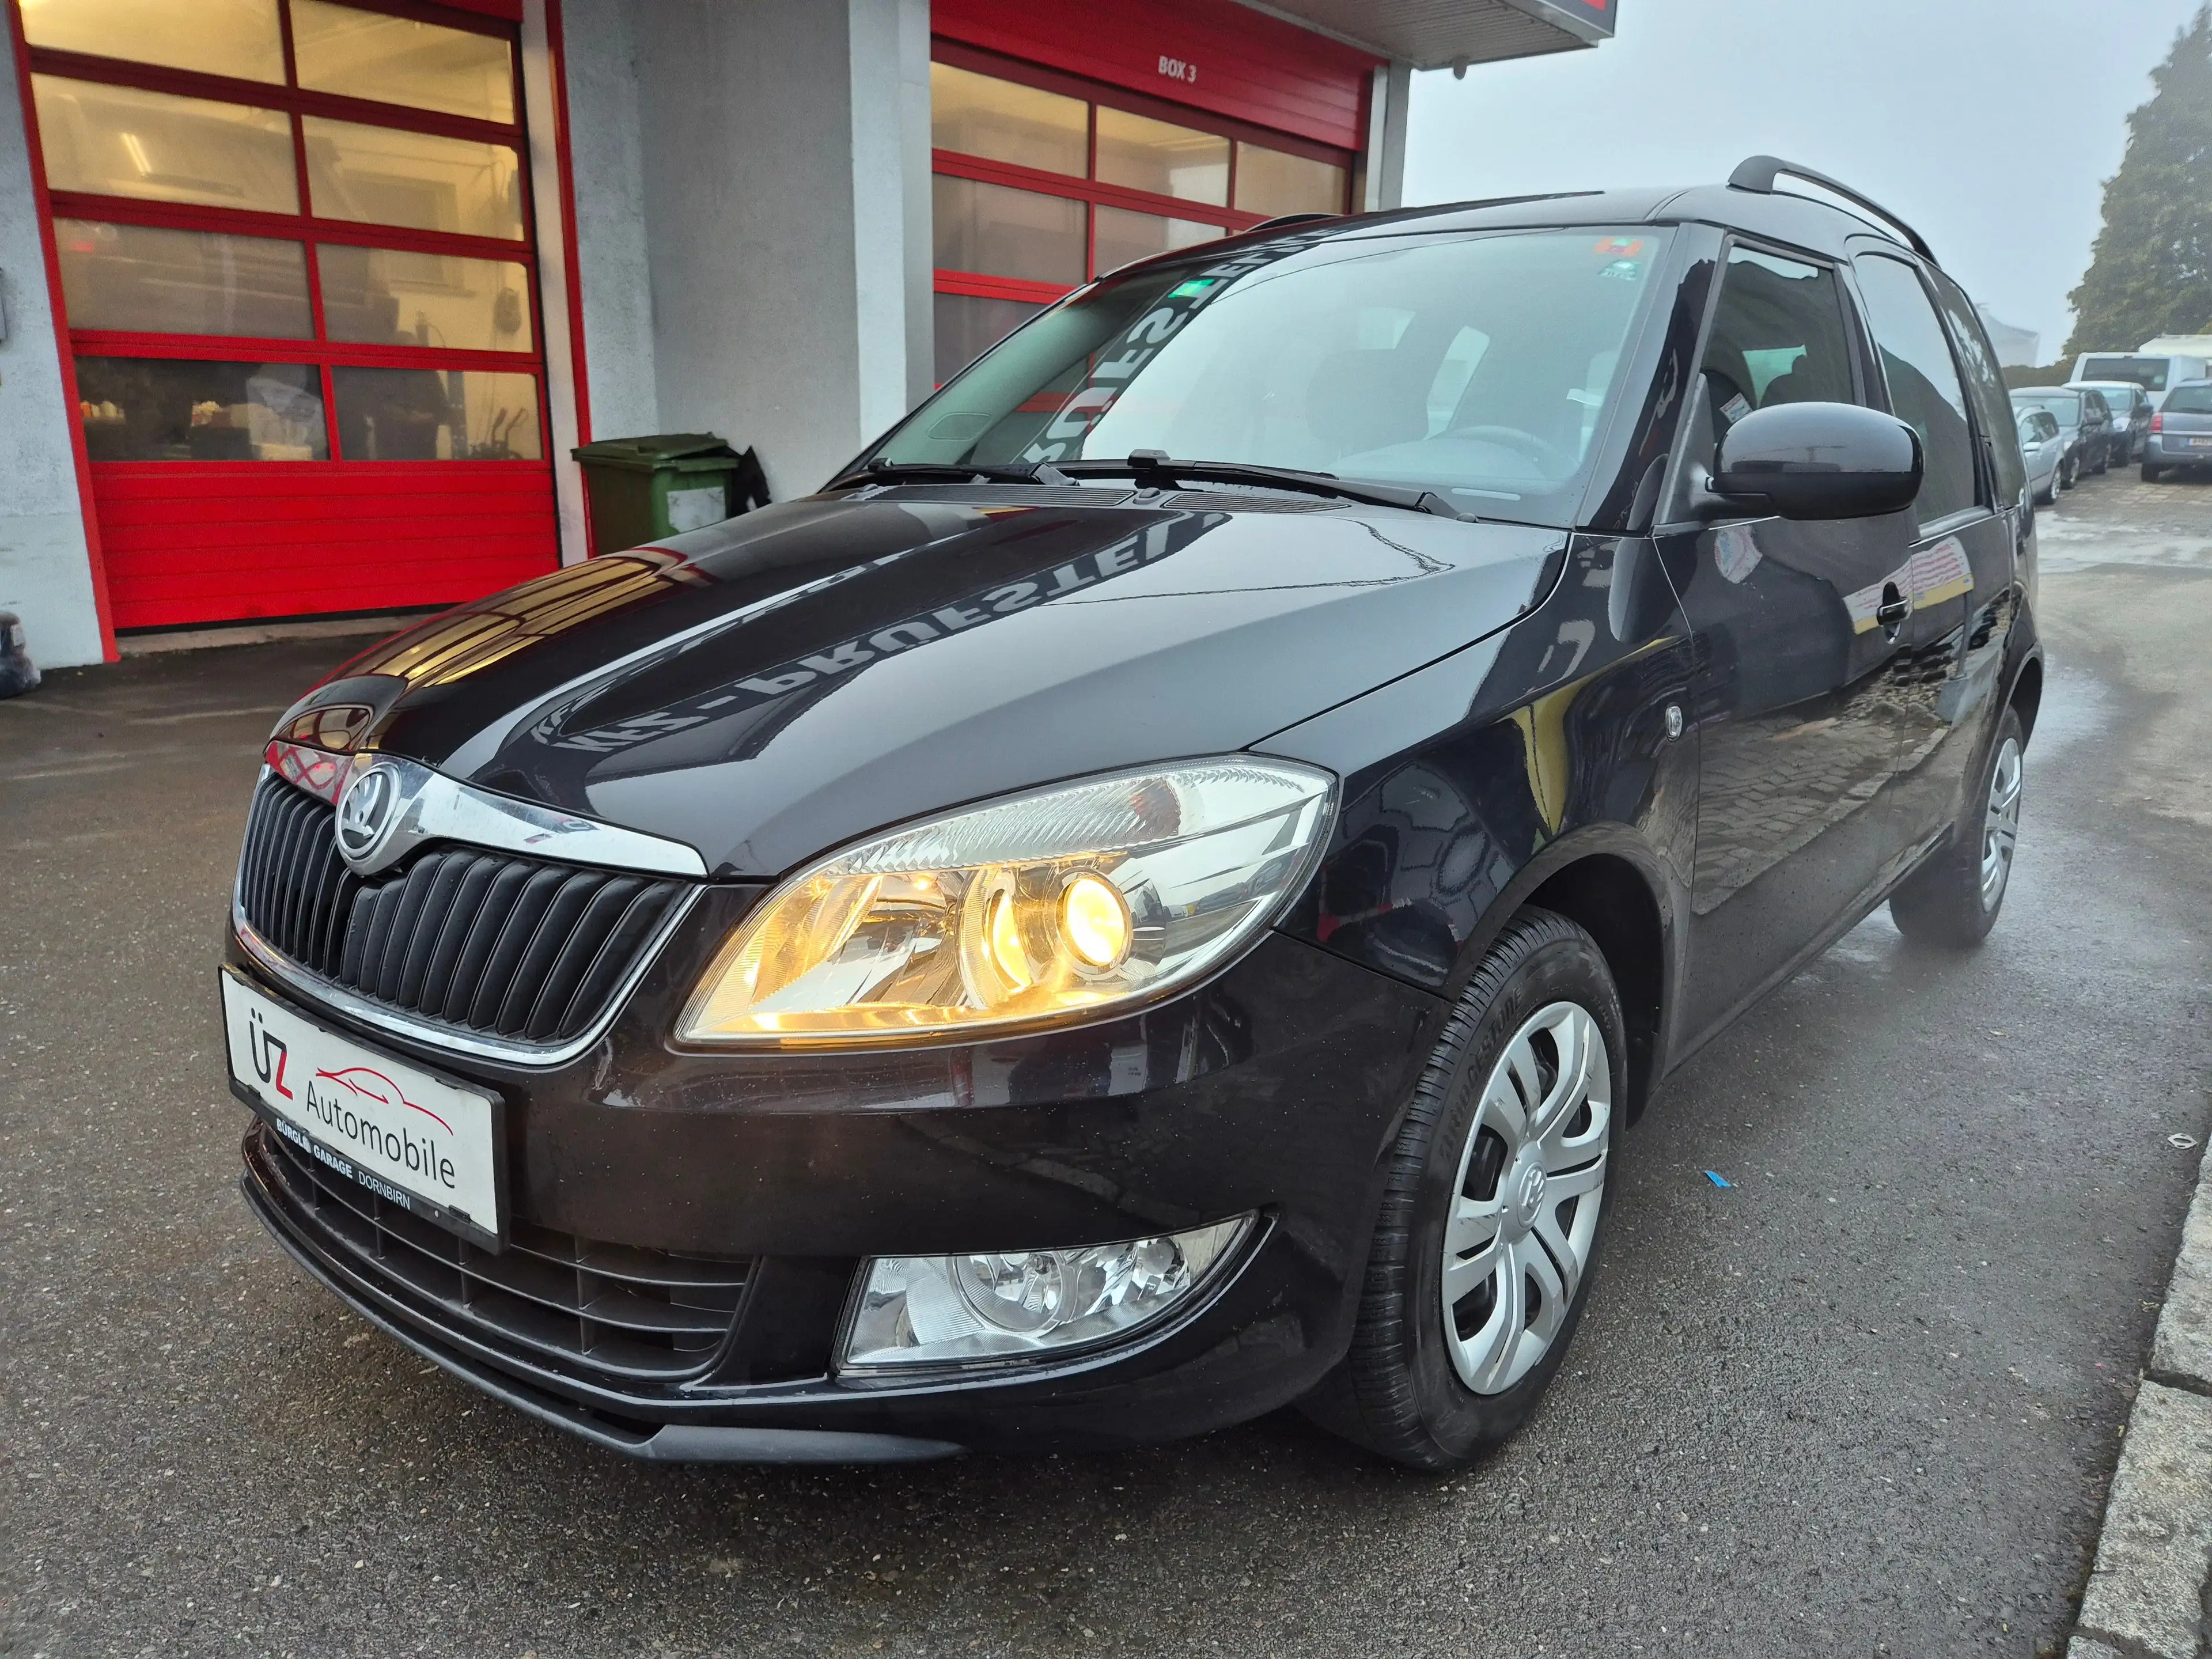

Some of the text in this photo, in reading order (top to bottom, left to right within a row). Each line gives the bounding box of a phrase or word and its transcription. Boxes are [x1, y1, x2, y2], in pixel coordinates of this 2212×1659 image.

[1158, 56, 1196, 84] BOX 3
[249, 1007, 294, 1101] ÜZ
[276, 1117, 411, 1210] BÜRGL GARAGE DORNBIRN
[306, 1080, 455, 1189] Automobile
